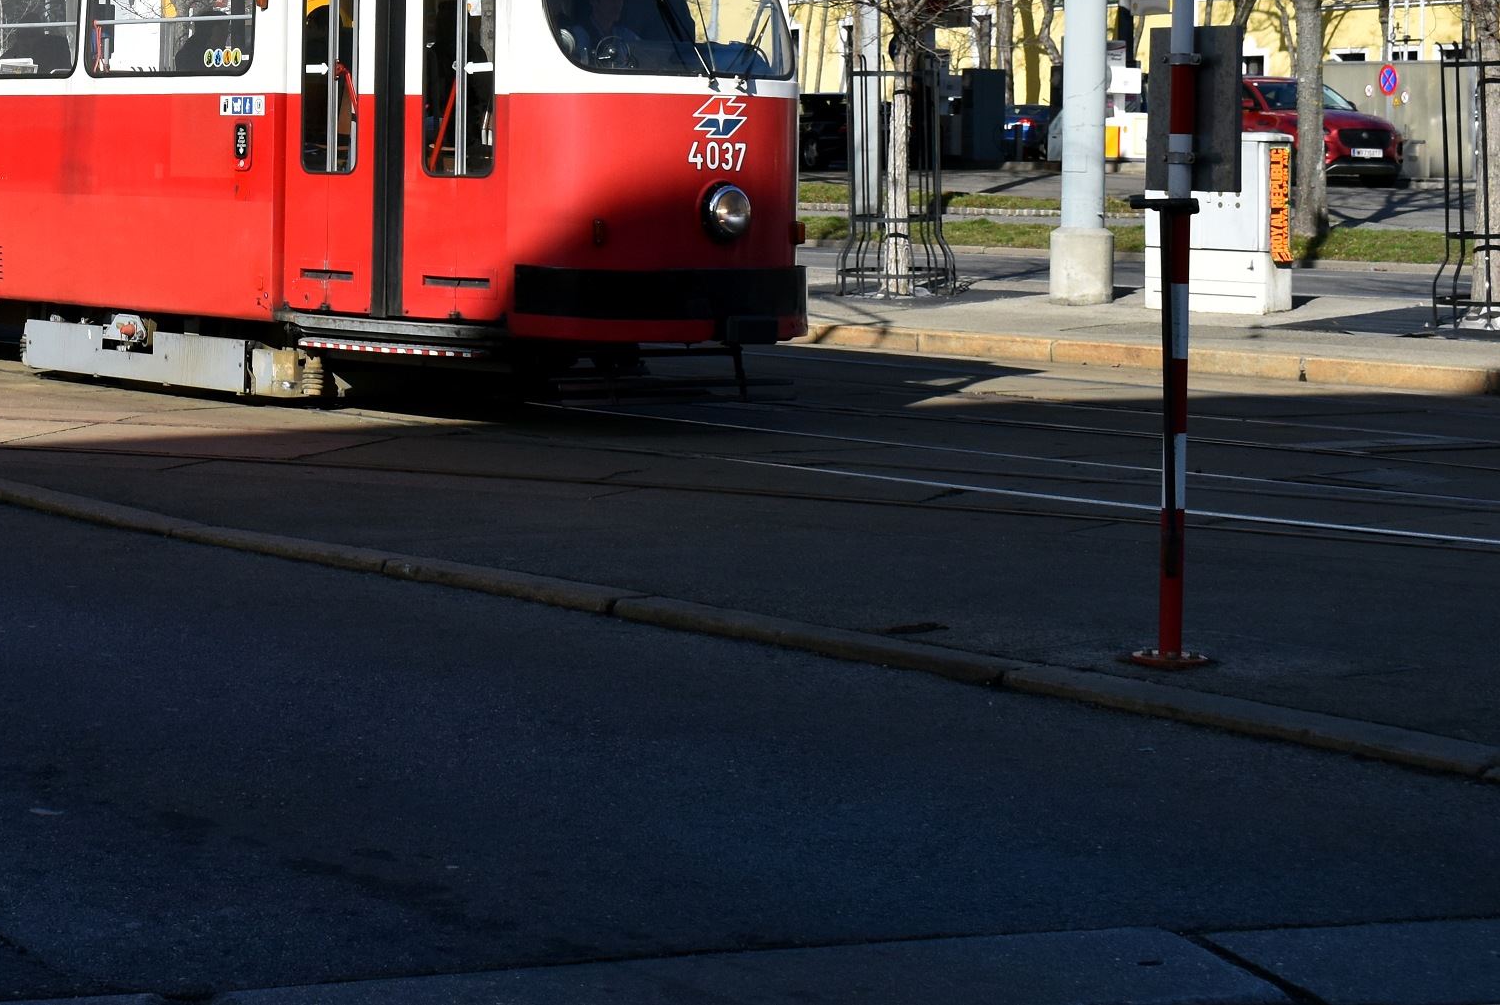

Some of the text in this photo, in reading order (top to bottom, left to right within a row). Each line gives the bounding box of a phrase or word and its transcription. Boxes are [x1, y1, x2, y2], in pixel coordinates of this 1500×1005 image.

[688, 142, 747, 172] 4037
[1270, 148, 1283, 253] ROYAL REPUBLIC
